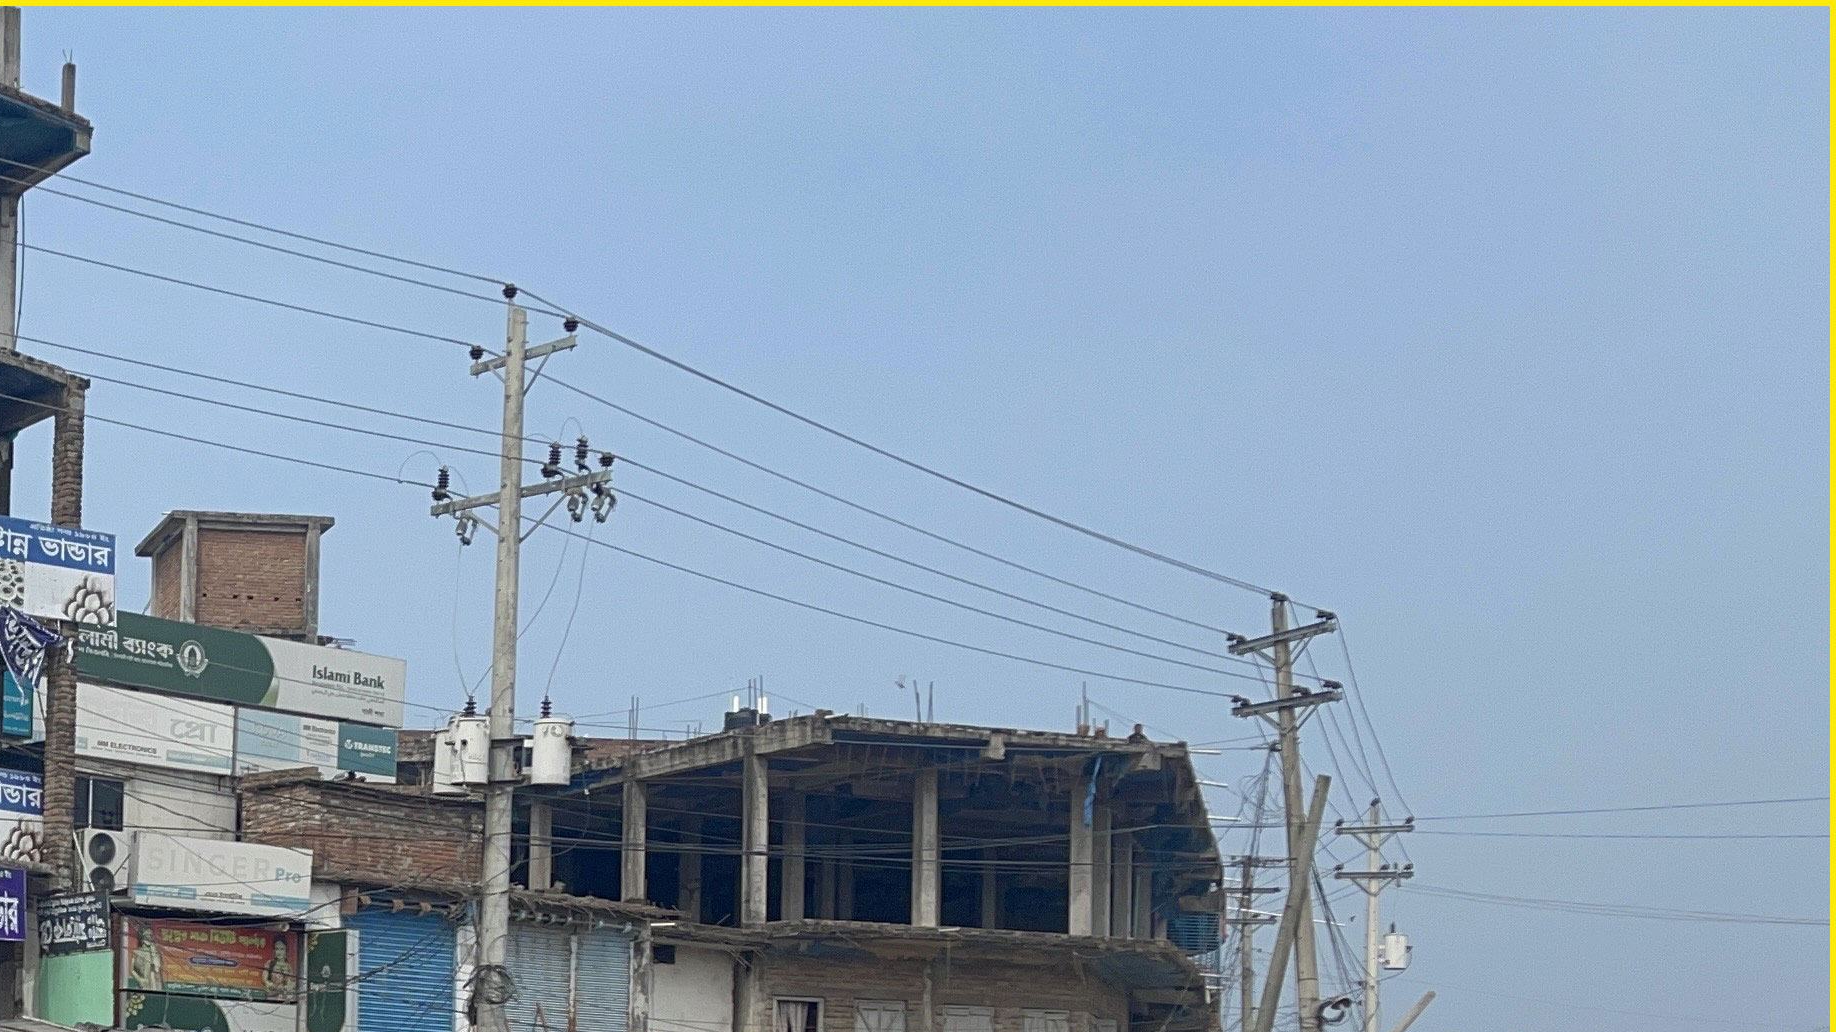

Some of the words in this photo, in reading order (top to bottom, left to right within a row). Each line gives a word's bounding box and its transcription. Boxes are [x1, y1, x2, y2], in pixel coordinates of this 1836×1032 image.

[39, 535, 111, 567] ভান্ডার
[78, 628, 118, 650] লামী
[122, 636, 174, 658] ব্যাংক
[312, 664, 350, 684] Islami
[353, 671, 385, 689] Bank
[147, 847, 271, 881] SINGER
[274, 867, 302, 884] Pro
